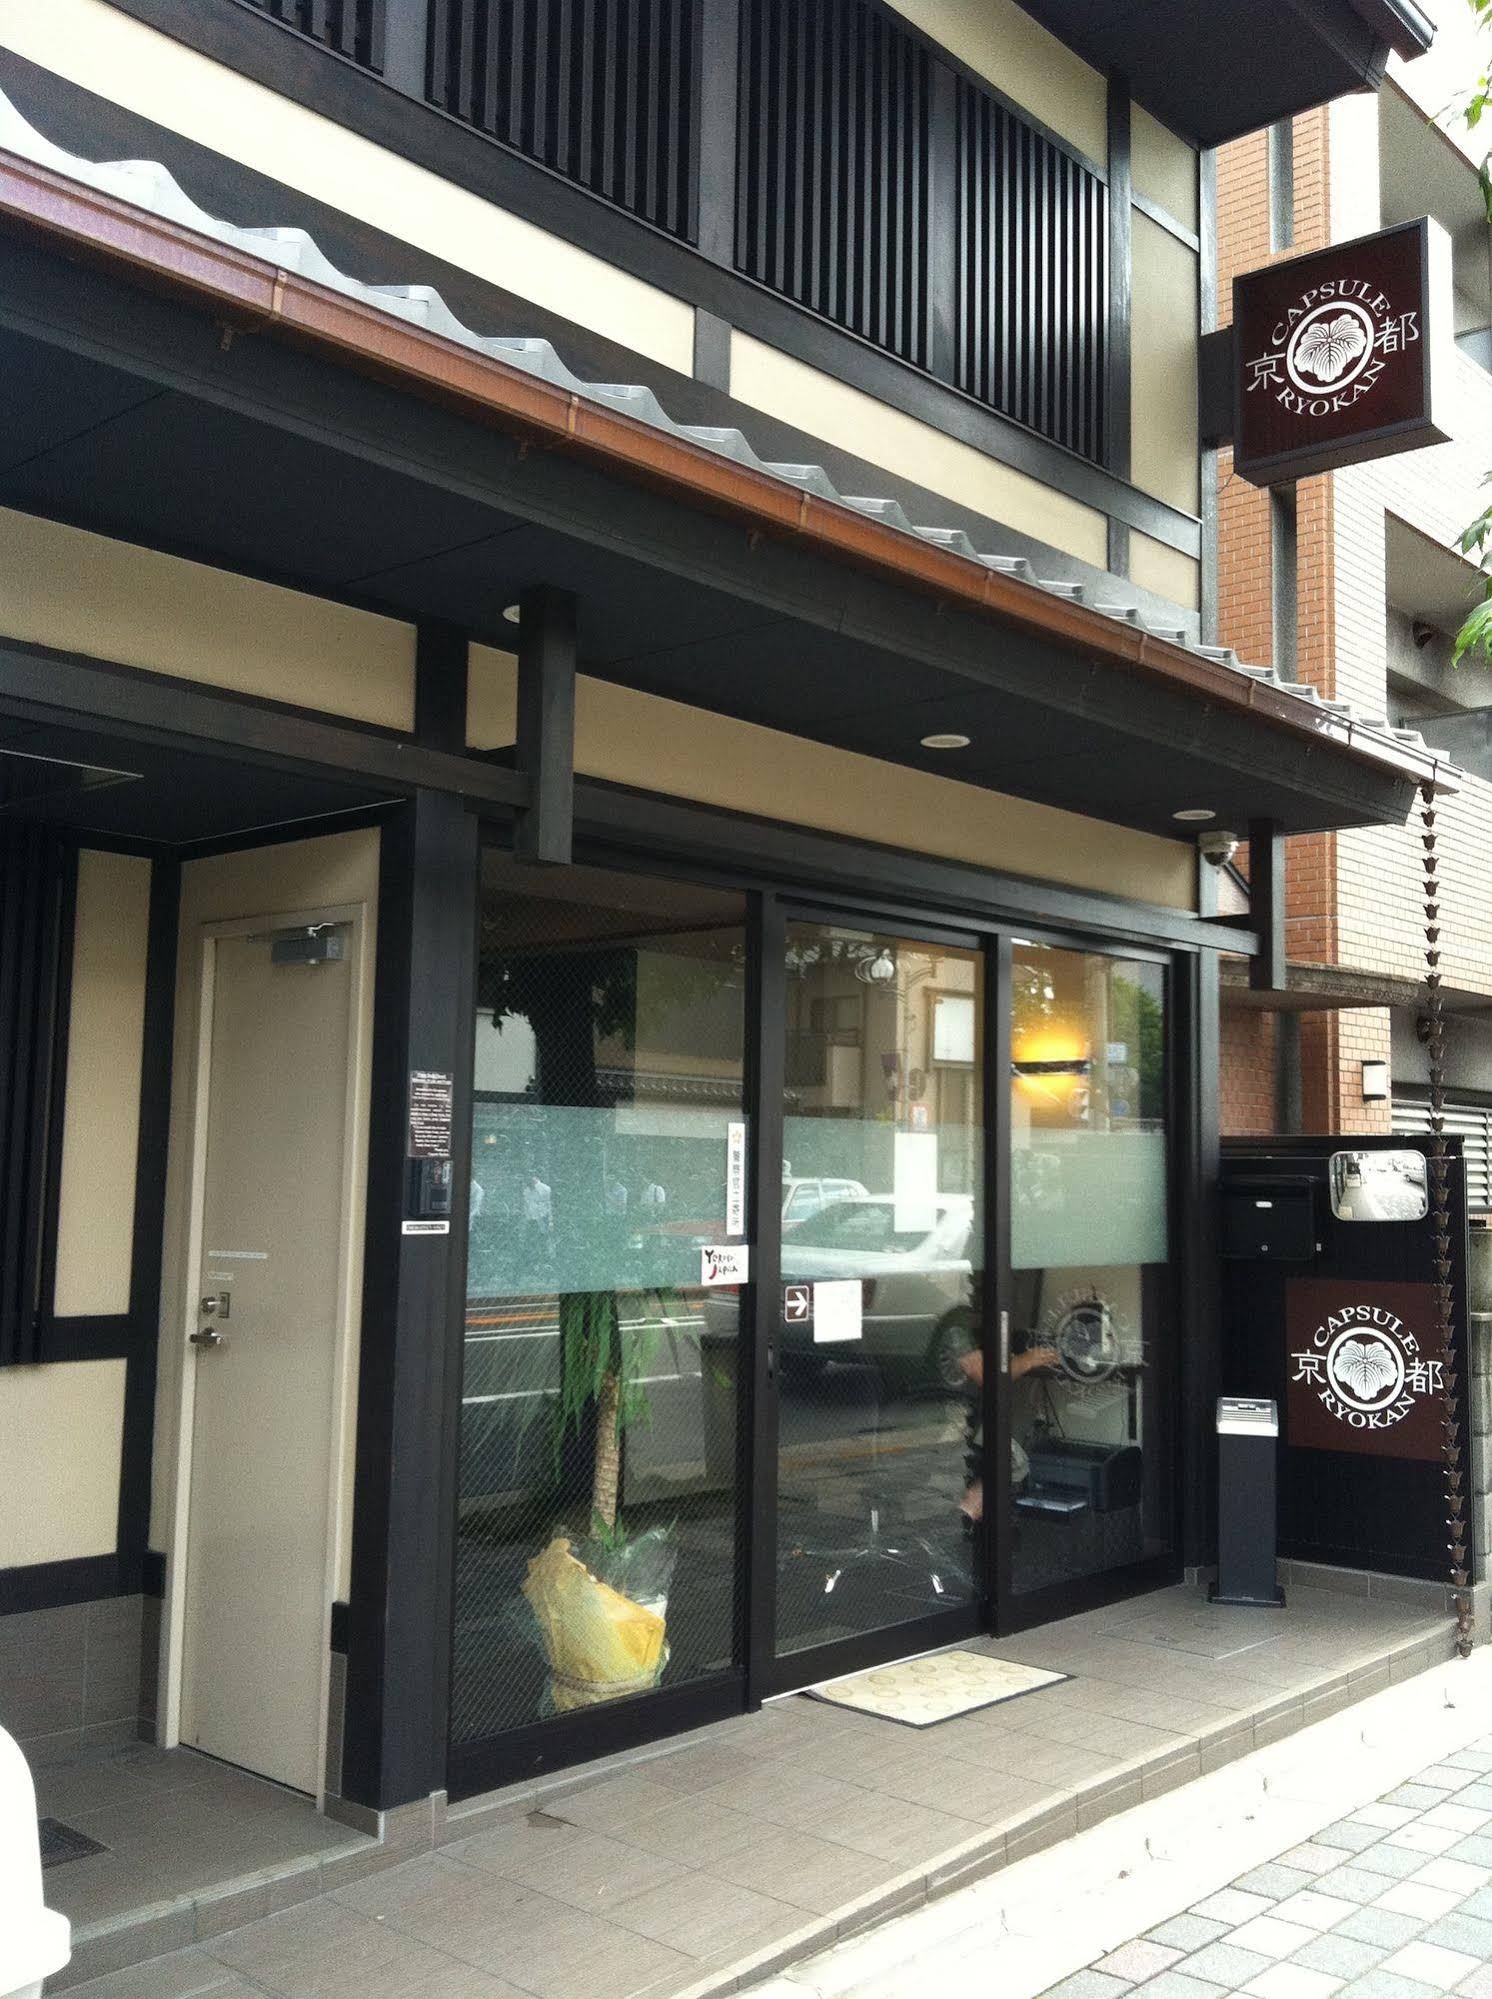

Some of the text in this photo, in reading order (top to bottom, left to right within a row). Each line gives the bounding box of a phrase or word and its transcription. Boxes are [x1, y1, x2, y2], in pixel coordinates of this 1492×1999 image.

[1271, 279, 1392, 346] CAPSULE
[1245, 311, 1420, 392] 京 都
[1275, 357, 1387, 417] RYOKAN
[1313, 1305, 1420, 1356] CAPSULE
[1290, 1348, 1444, 1395] 京 都
[1317, 1387, 1416, 1429] RYOKAN
